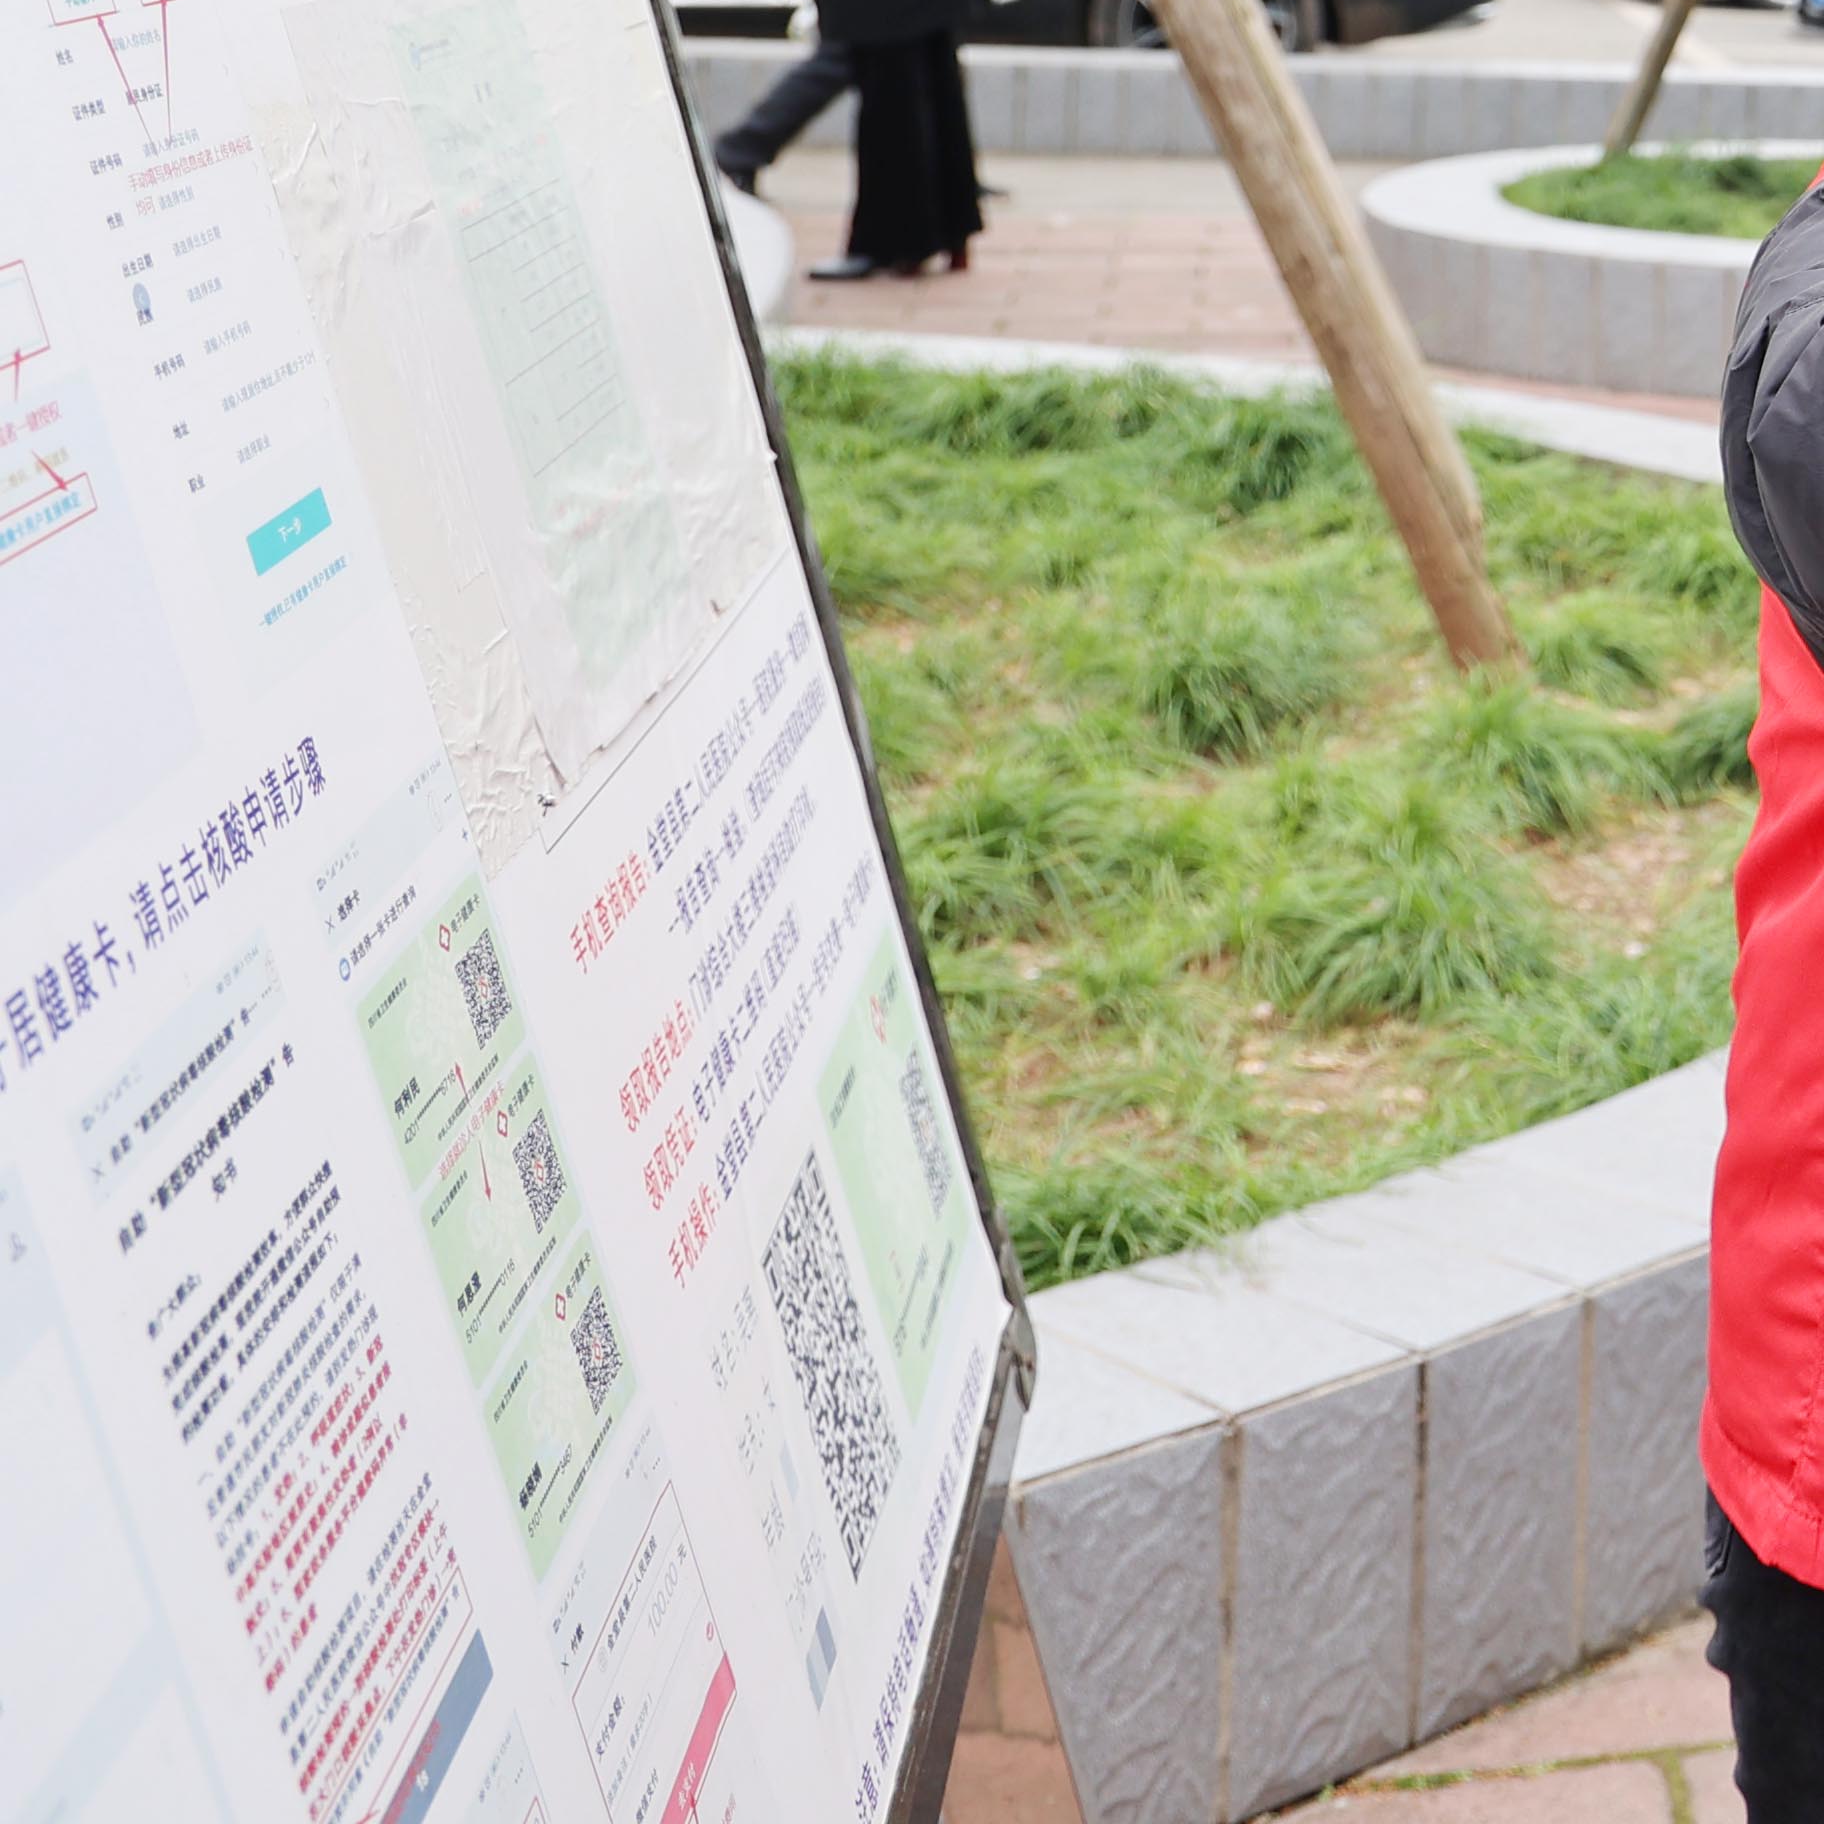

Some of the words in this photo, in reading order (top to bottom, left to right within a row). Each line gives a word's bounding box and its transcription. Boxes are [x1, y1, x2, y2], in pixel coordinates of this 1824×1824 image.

[336, 886, 361, 921] 选择卡
[350, 886, 416, 966] 请选择一张卡进行查询
[450, 891, 480, 935] 电子健康卡
[392, 1074, 421, 1121] 何利民
[506, 1072, 536, 1121] 电子健康卡
